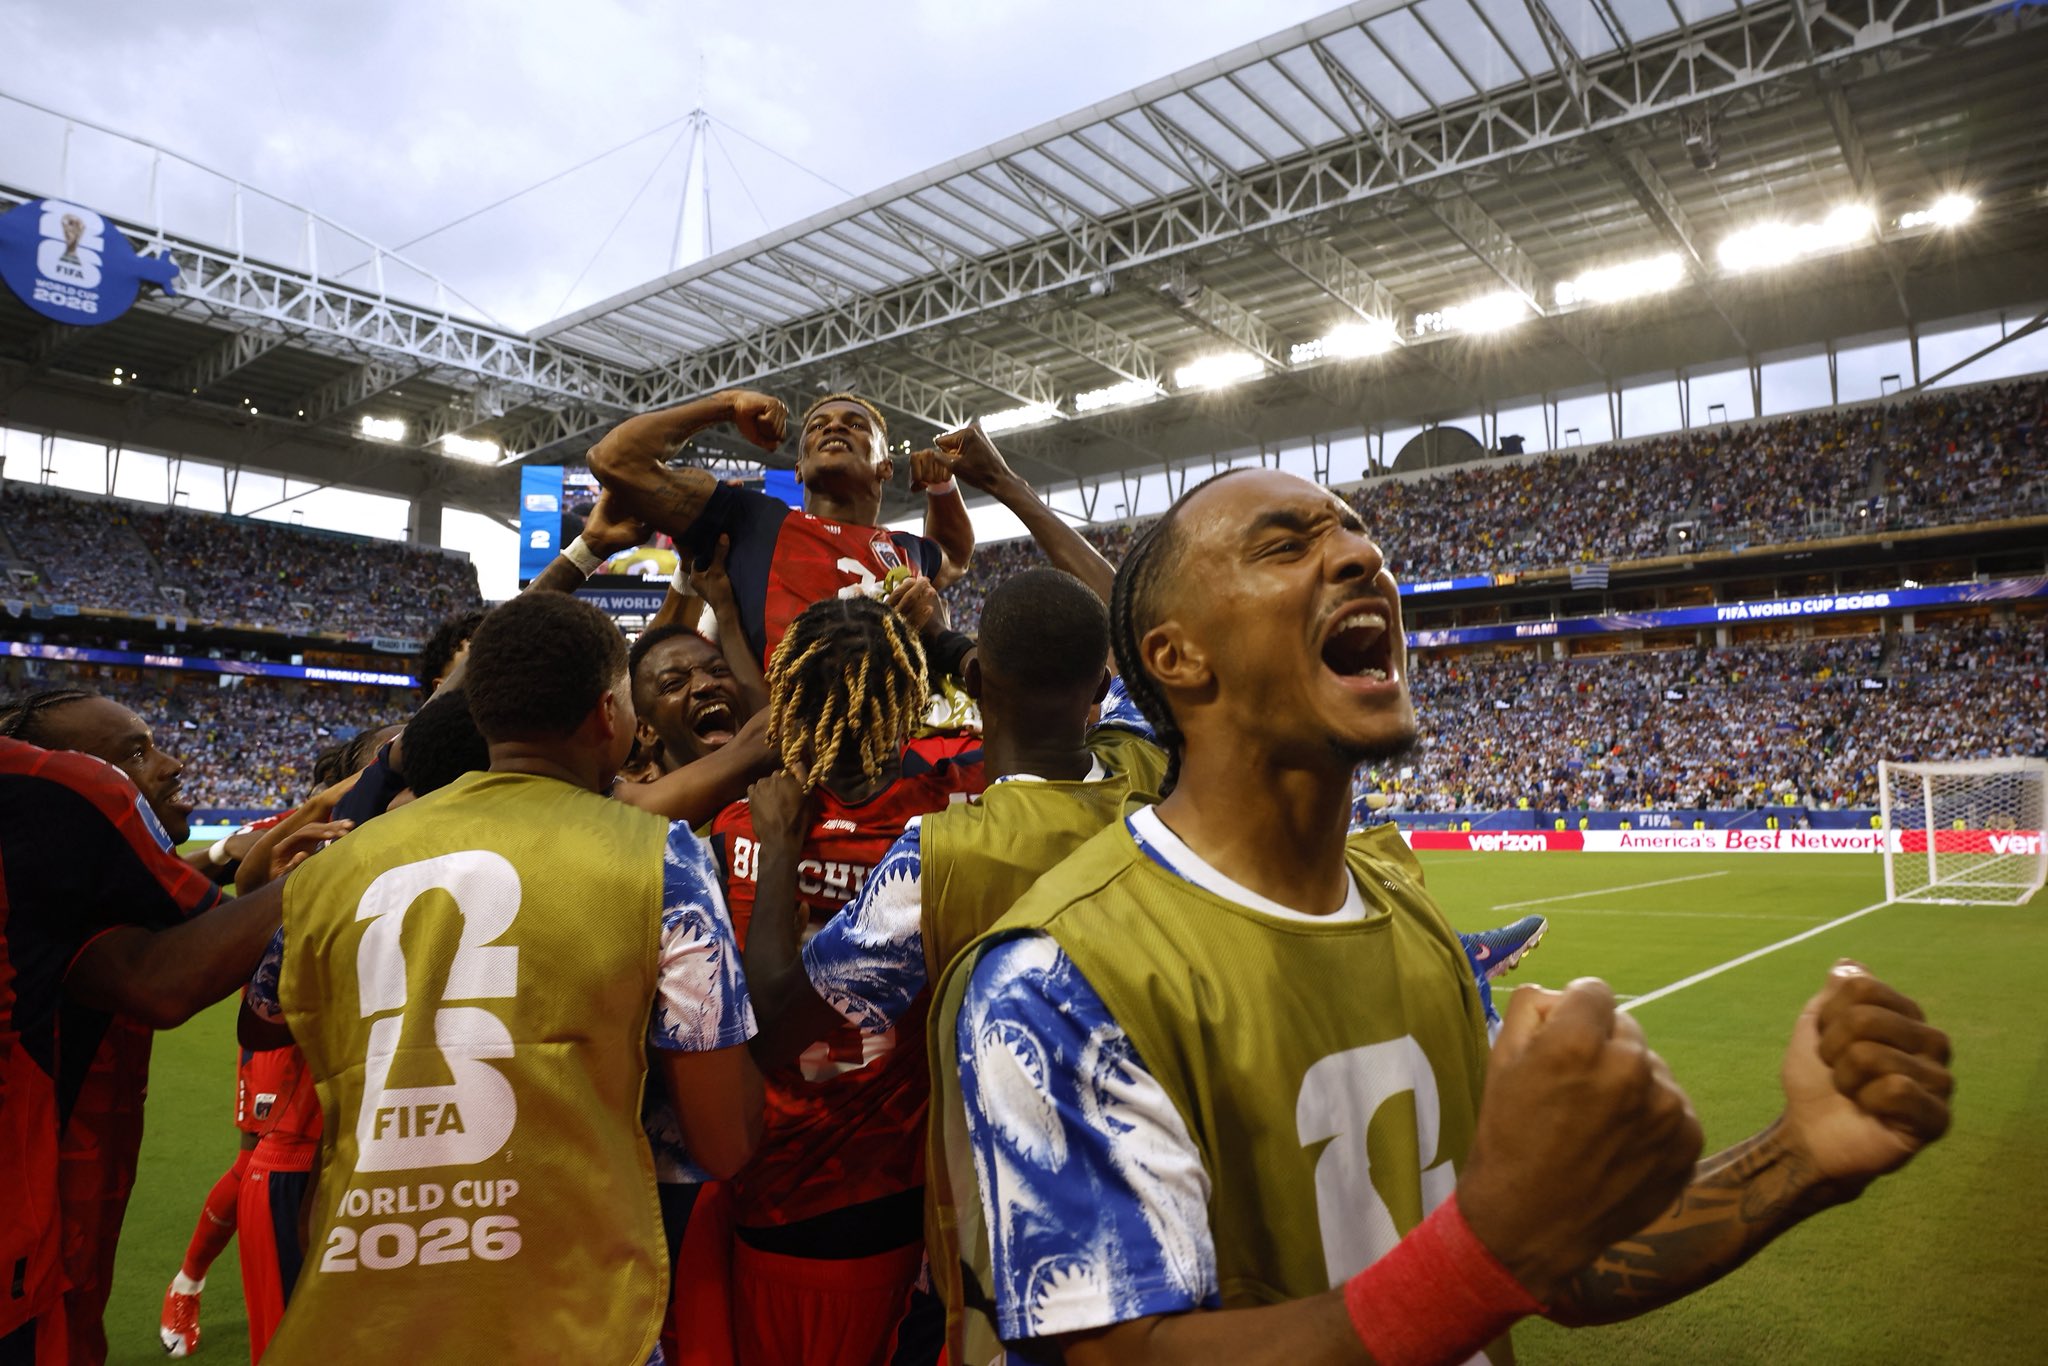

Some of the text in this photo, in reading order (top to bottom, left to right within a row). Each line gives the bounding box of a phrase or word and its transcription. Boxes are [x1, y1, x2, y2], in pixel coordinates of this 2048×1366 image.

[56, 265, 84, 279] FIFA
[35, 279, 99, 301] WORLD CUP
[33, 287, 98, 314] 2026
[530, 530, 551, 549] 2
[611, 597, 662, 609] WORLD
[1717, 594, 1891, 620] FIFA WORLD CUP 2026
[1516, 623, 1558, 637] MIAMI
[144, 654, 183, 667] MIAMI
[305, 668, 327, 679] FIFA
[327, 670, 360, 682] WORLD
[360, 672, 379, 683] CUP
[1639, 814, 1671, 827] FIFA
[1468, 831, 1547, 851] verizon
[1620, 833, 1716, 848] America's
[1725, 829, 1782, 849] Best
[1791, 833, 1885, 849] Network
[373, 1102, 466, 1141] FIFA
[336, 1179, 521, 1218] ORLD CUP
[319, 1215, 523, 1273] 2026
